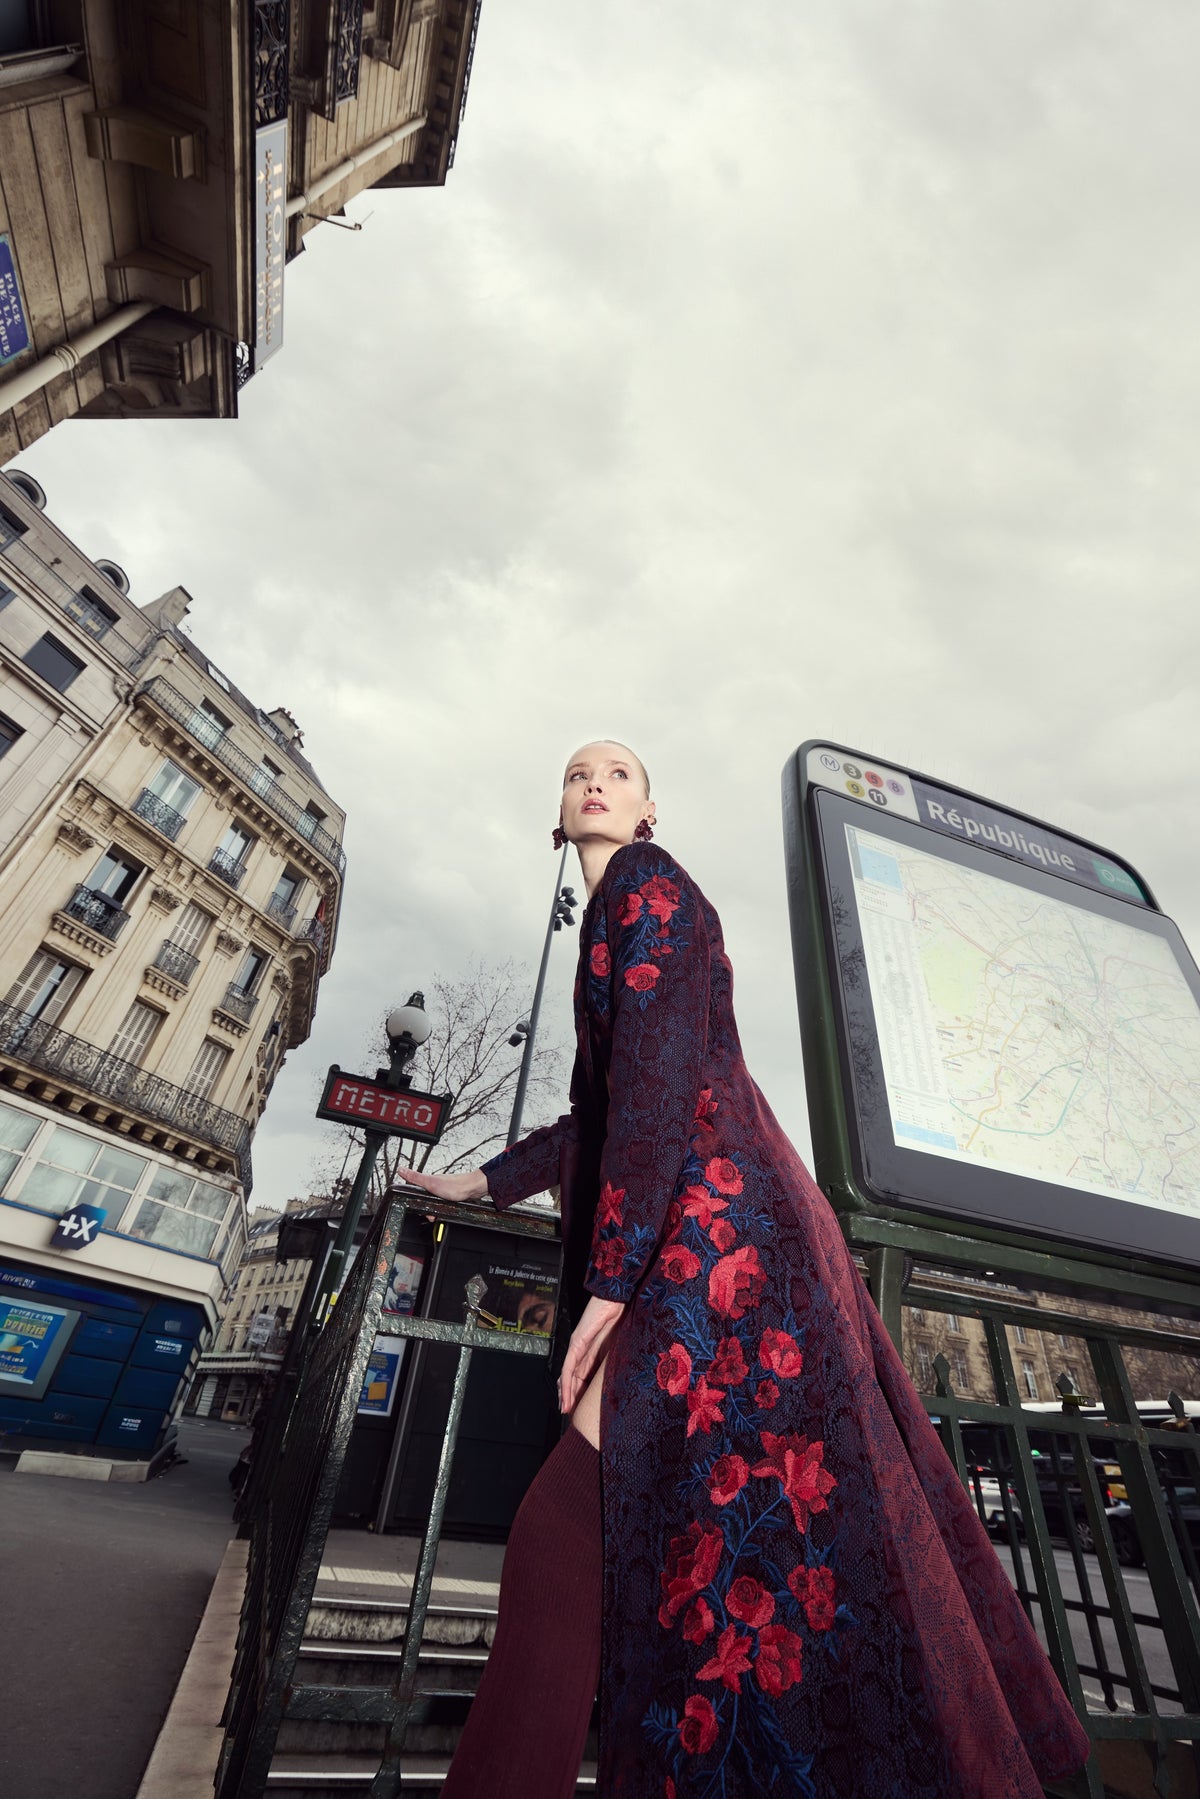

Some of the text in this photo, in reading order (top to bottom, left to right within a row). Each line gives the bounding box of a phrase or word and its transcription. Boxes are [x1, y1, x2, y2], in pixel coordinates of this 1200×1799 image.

[0, 278, 13, 327] DE LA
[4, 272, 21, 325] PLACE
[257, 271, 265, 307] 50
[870, 790, 884, 805] 11
[926, 799, 1076, 872] République
[335, 1083, 433, 1127] METRO
